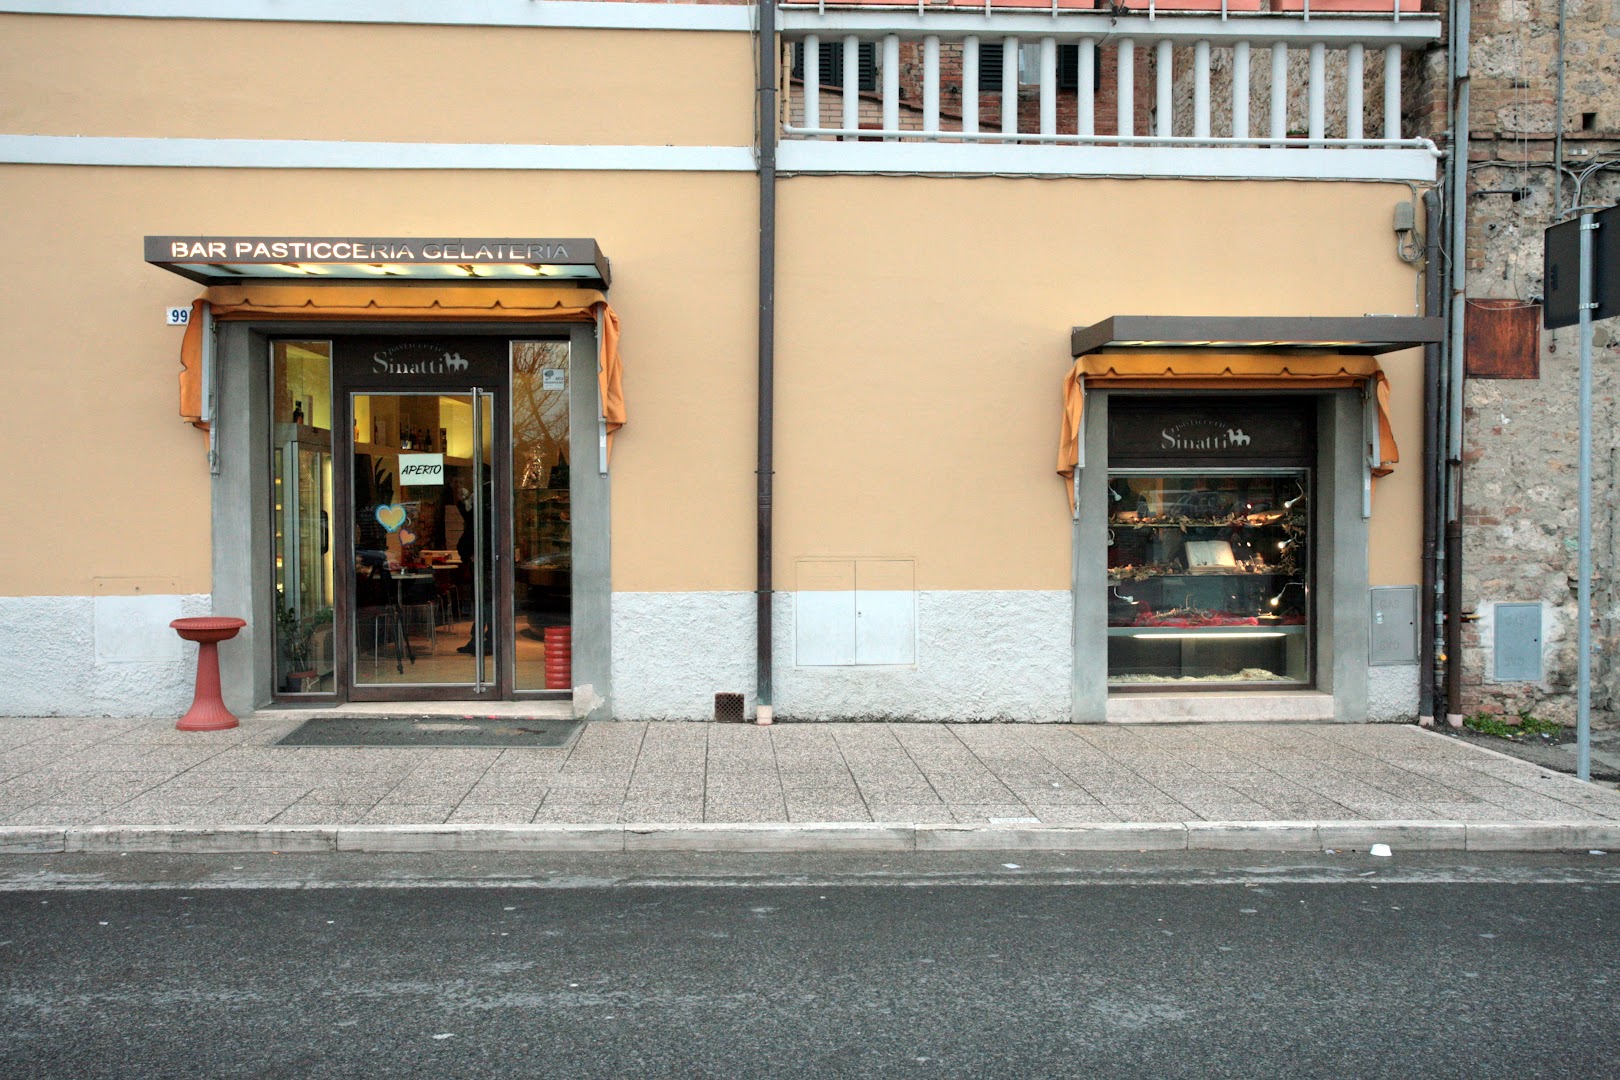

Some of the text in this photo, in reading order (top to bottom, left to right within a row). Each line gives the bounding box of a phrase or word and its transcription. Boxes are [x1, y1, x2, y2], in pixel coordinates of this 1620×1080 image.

[171, 242, 569, 259] BAR PASTICCERIA GELATERIA
[172, 309, 188, 323] 99
[372, 351, 443, 374] Sinatti
[1161, 428, 1227, 449] Sinatti
[401, 464, 442, 475] APERTO
